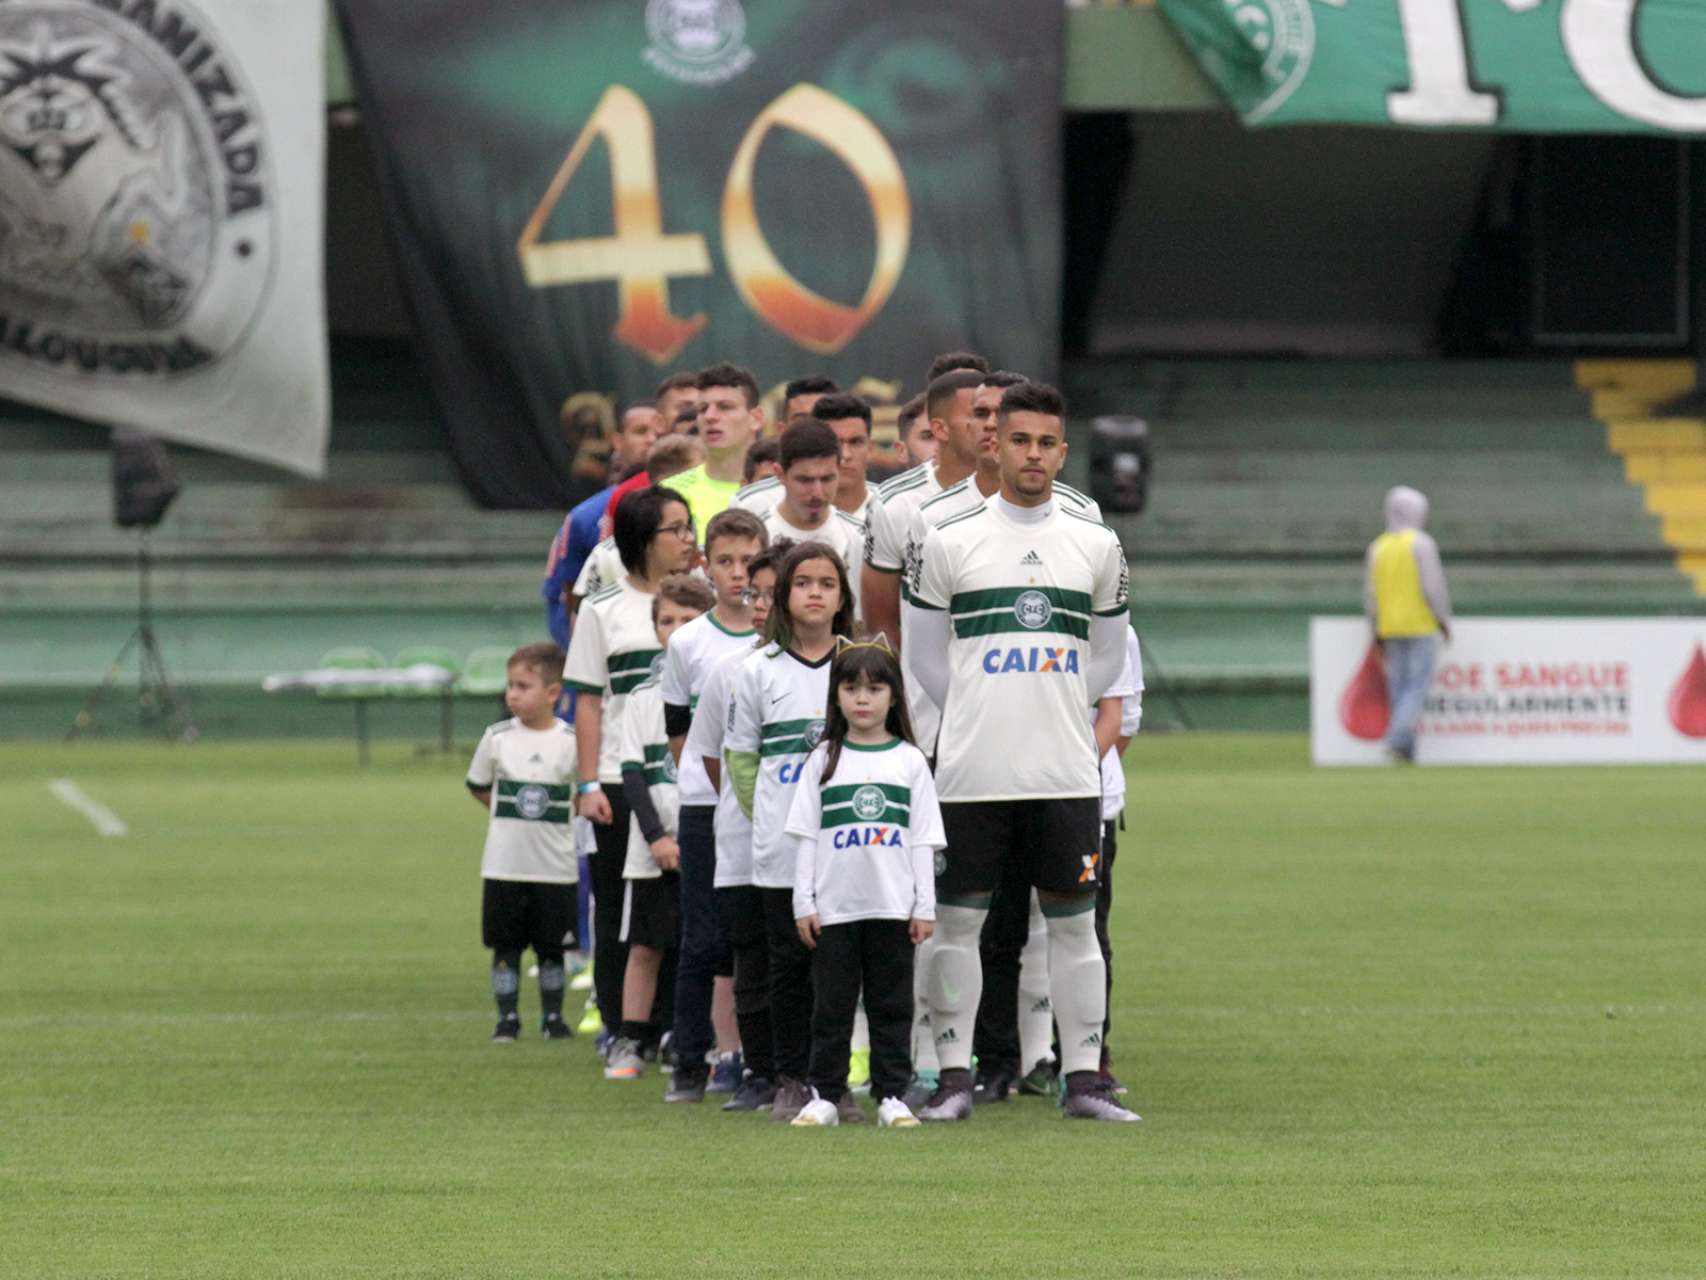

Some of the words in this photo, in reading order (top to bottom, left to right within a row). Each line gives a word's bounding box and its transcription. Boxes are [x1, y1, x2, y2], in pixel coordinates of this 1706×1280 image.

[517, 83, 911, 364] 40
[983, 647, 1079, 674] CAIXA
[1496, 664, 1628, 689] SANGUE
[834, 827, 903, 849] CAIXA
